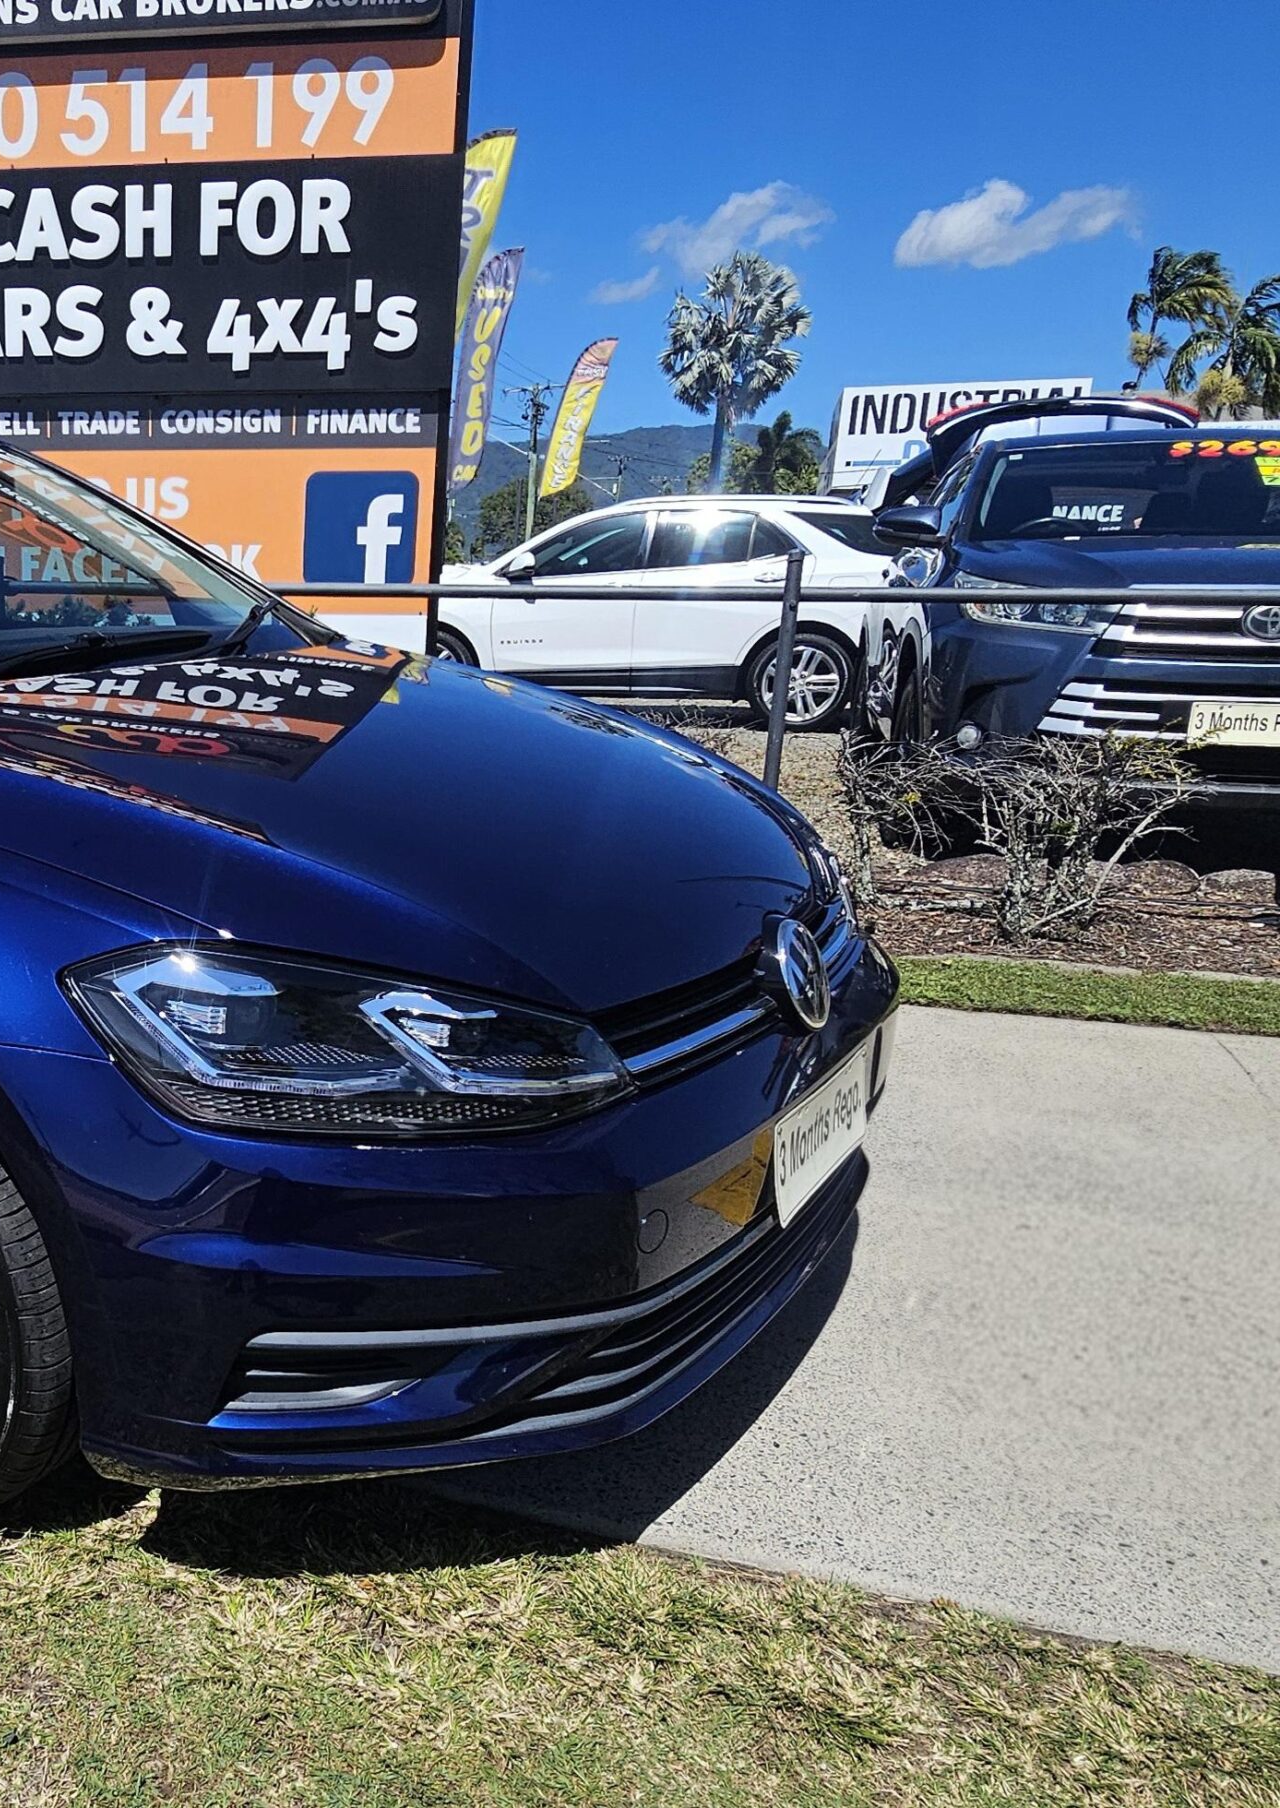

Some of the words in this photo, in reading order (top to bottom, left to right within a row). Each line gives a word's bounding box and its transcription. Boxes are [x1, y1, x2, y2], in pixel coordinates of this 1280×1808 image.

[60, 61, 214, 157] 514
[243, 55, 395, 148] 199
[199, 178, 352, 257] FOR
[126, 286, 188, 357] &
[461, 306, 502, 456] USED
[58, 410, 141, 435] TRADE
[160, 408, 281, 434] CONSIGN
[307, 408, 421, 434] FINANCE
[548, 386, 593, 488] FINANCE
[126, 476, 189, 519] US
[1194, 711, 1205, 730] 3
[1209, 711, 1268, 732] Months
[779, 1140, 787, 1187] 3
[789, 1107, 830, 1177] Months
